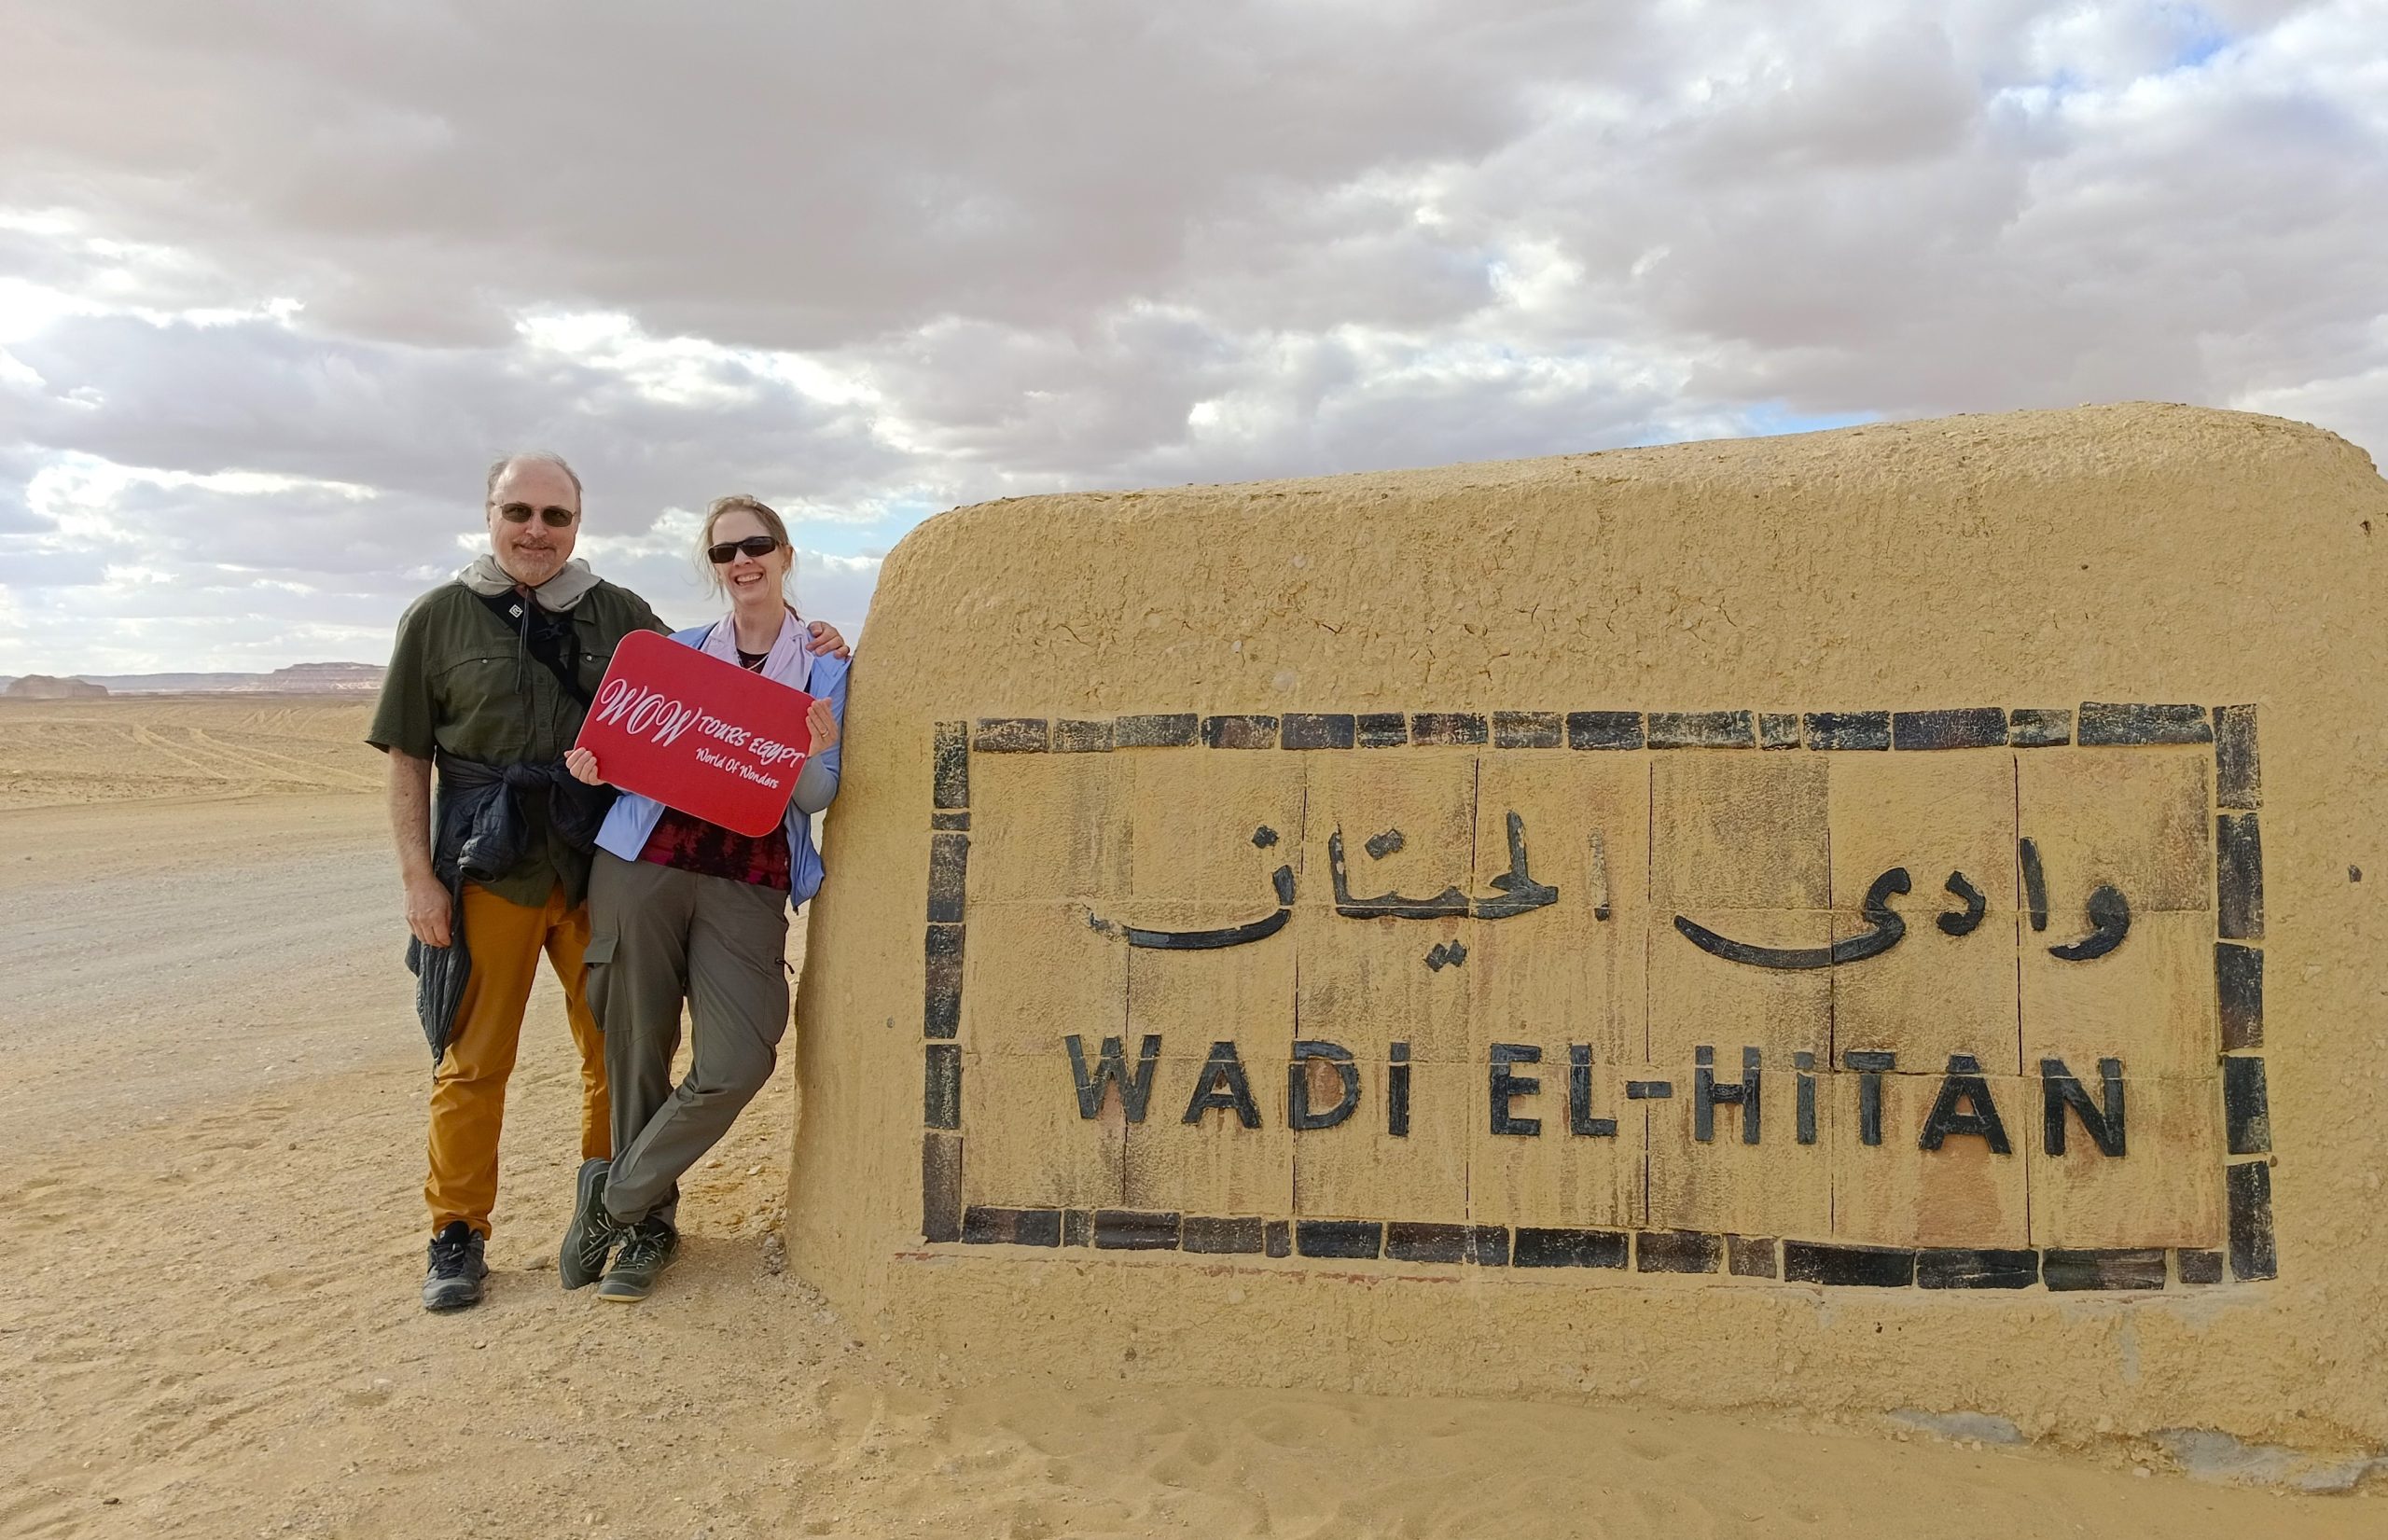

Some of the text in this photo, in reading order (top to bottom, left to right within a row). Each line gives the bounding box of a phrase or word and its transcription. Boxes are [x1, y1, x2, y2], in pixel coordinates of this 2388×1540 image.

[596, 678, 805, 769] WOW TOURS EGYPT
[696, 748, 780, 789] World Of Wonders
[1064, 1034, 1412, 1138] WADI
